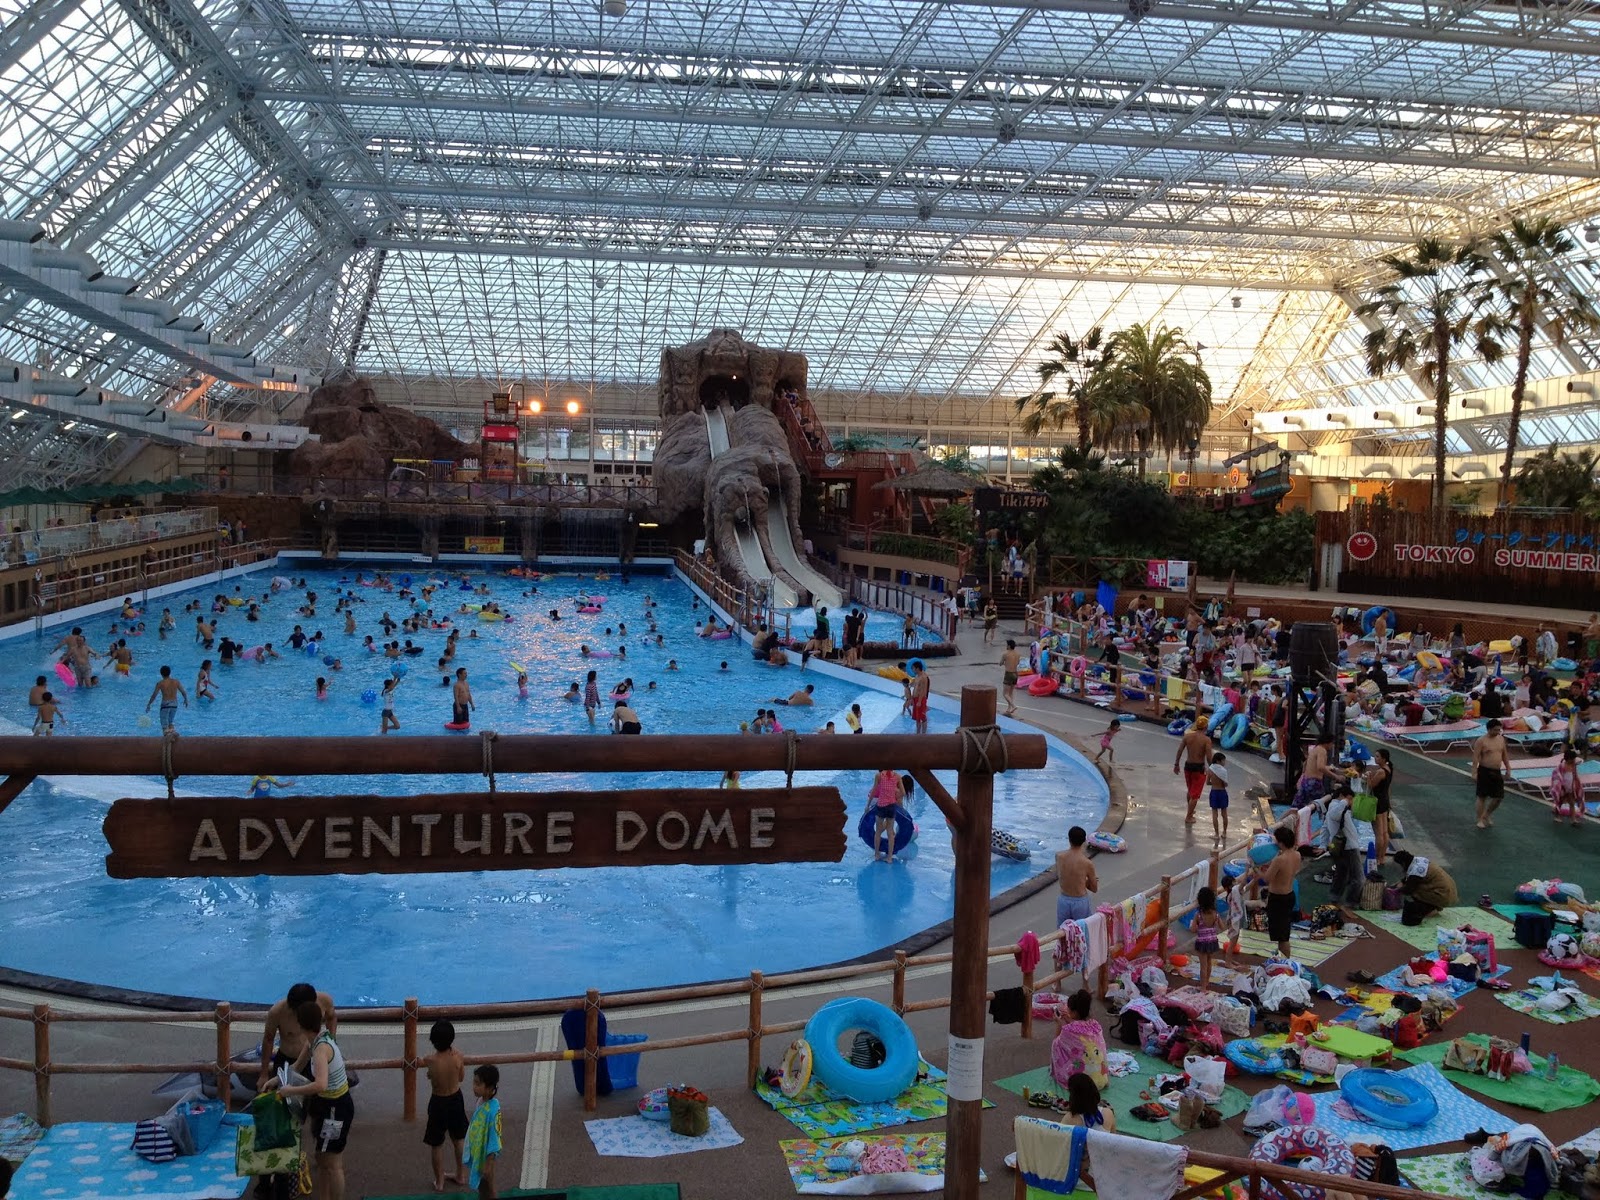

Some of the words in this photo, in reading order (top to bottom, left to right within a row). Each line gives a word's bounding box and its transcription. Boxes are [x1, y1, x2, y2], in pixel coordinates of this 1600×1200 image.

[1455, 528, 1600, 549] ウォーターアドベ
[1394, 544, 1475, 564] TOKYO
[1495, 549, 1600, 572] SUMMER
[189, 811, 575, 861] ADVENTURE
[615, 807, 776, 851] DOME
